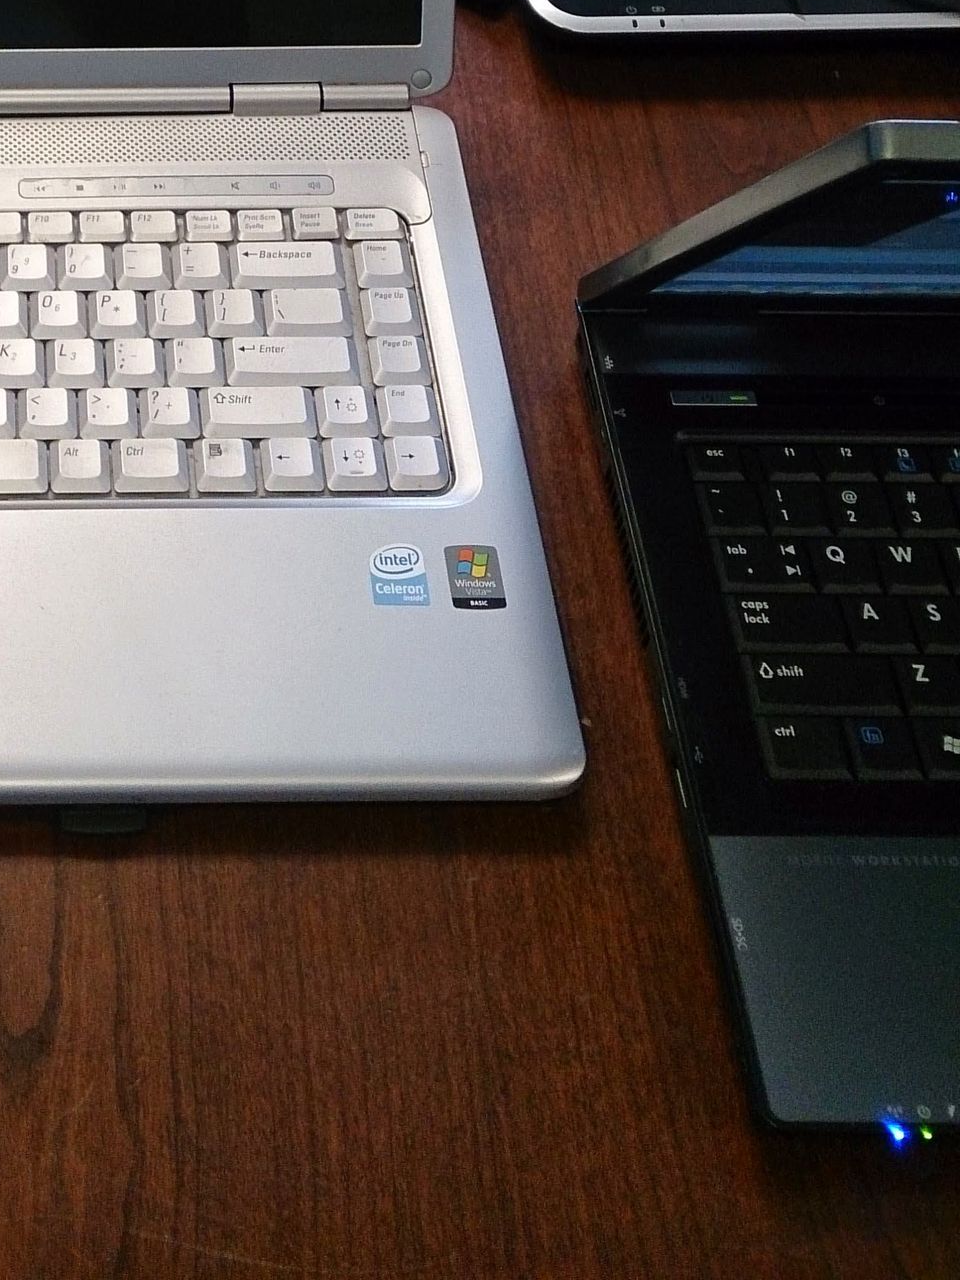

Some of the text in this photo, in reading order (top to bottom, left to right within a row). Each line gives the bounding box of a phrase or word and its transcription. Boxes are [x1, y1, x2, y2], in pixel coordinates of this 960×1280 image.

[35, 215, 49, 223] F10
[86, 215, 100, 223] F11
[137, 214, 151, 222] F12
[300, 212, 320, 220] Insert
[259, 249, 312, 260] Backspace
[11, 264, 19, 274] 9
[101, 294, 112, 307] P
[374, 290, 404, 300] Page Up
[42, 295, 53, 308] O
[259, 344, 285, 353] Enter
[382, 340, 400, 348] Page
[0, 344, 11, 356] K
[59, 344, 67, 356] L
[228, 394, 252, 404] Shift
[64, 448, 79, 457] Alt
[126, 447, 144, 456] Ctrl
[706, 449, 724, 457] esc
[841, 447, 852, 457] f2
[897, 448, 909, 458] f3
[841, 490, 857, 504] @
[906, 491, 916, 504] #
[781, 510, 789, 520] 1
[847, 511, 857, 522] 2
[911, 511, 921, 522] 3
[726, 545, 747, 555] tab
[826, 546, 845, 564] Q
[889, 546, 912, 563] W
[379, 553, 413, 566] intel
[376, 583, 424, 594] Celeron
[455, 578, 497, 588] Windows
[741, 600, 769, 611] caps
[863, 603, 879, 620] A
[926, 604, 941, 621] S
[744, 612, 770, 624] lock
[776, 666, 804, 677] shift
[912, 664, 930, 682] Z
[775, 726, 796, 737] ctrl
